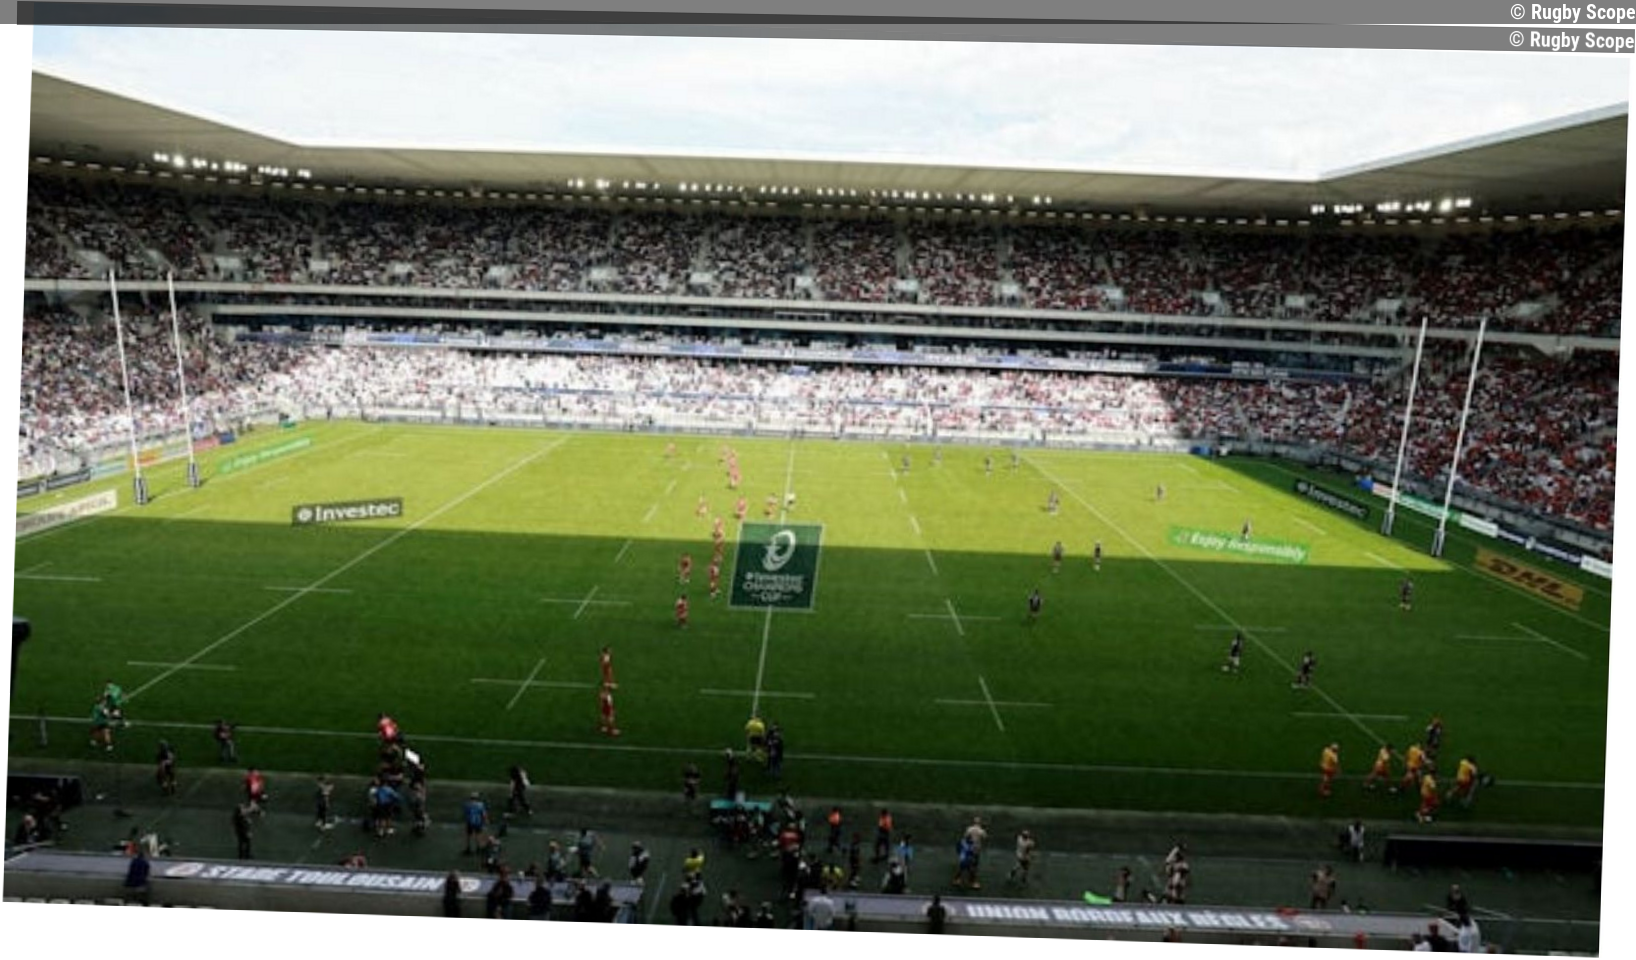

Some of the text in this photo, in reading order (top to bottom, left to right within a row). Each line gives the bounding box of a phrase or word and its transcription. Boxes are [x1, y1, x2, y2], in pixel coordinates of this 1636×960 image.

[314, 502, 400, 522] Investec
[1489, 558, 1565, 599] DHL
[201, 864, 447, 892] STADE TOULOUSAIN
[966, 904, 1050, 920] UNION
[1052, 907, 1188, 926] BORDEAUX
